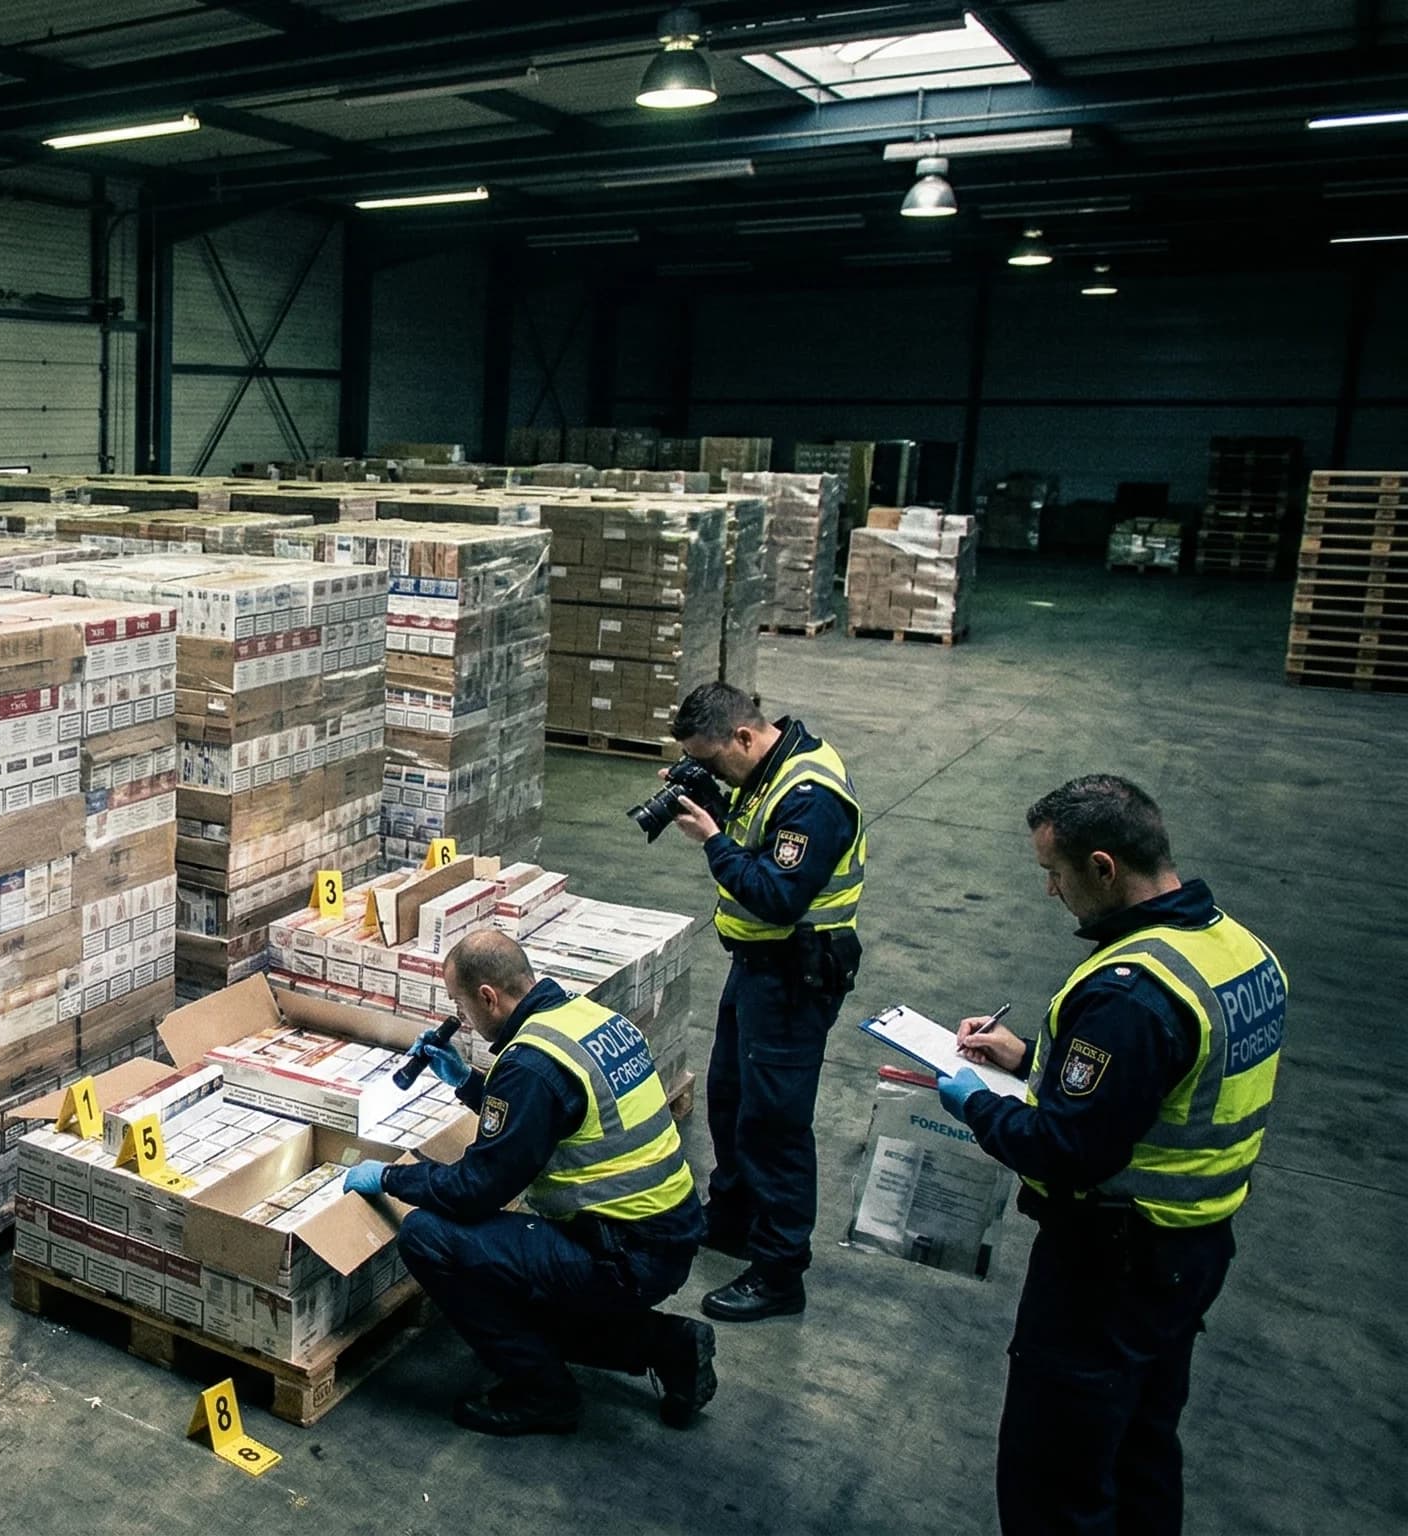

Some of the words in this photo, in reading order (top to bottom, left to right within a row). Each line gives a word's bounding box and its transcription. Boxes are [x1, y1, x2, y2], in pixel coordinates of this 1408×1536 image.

[441, 845, 452, 866] 6
[325, 879, 337, 905] 3
[1222, 965, 1285, 1032] POLICE
[82, 1089, 94, 1121] 1
[142, 1126, 157, 1161] 5
[216, 1395, 232, 1431] 8
[237, 1447, 261, 1462] 8
